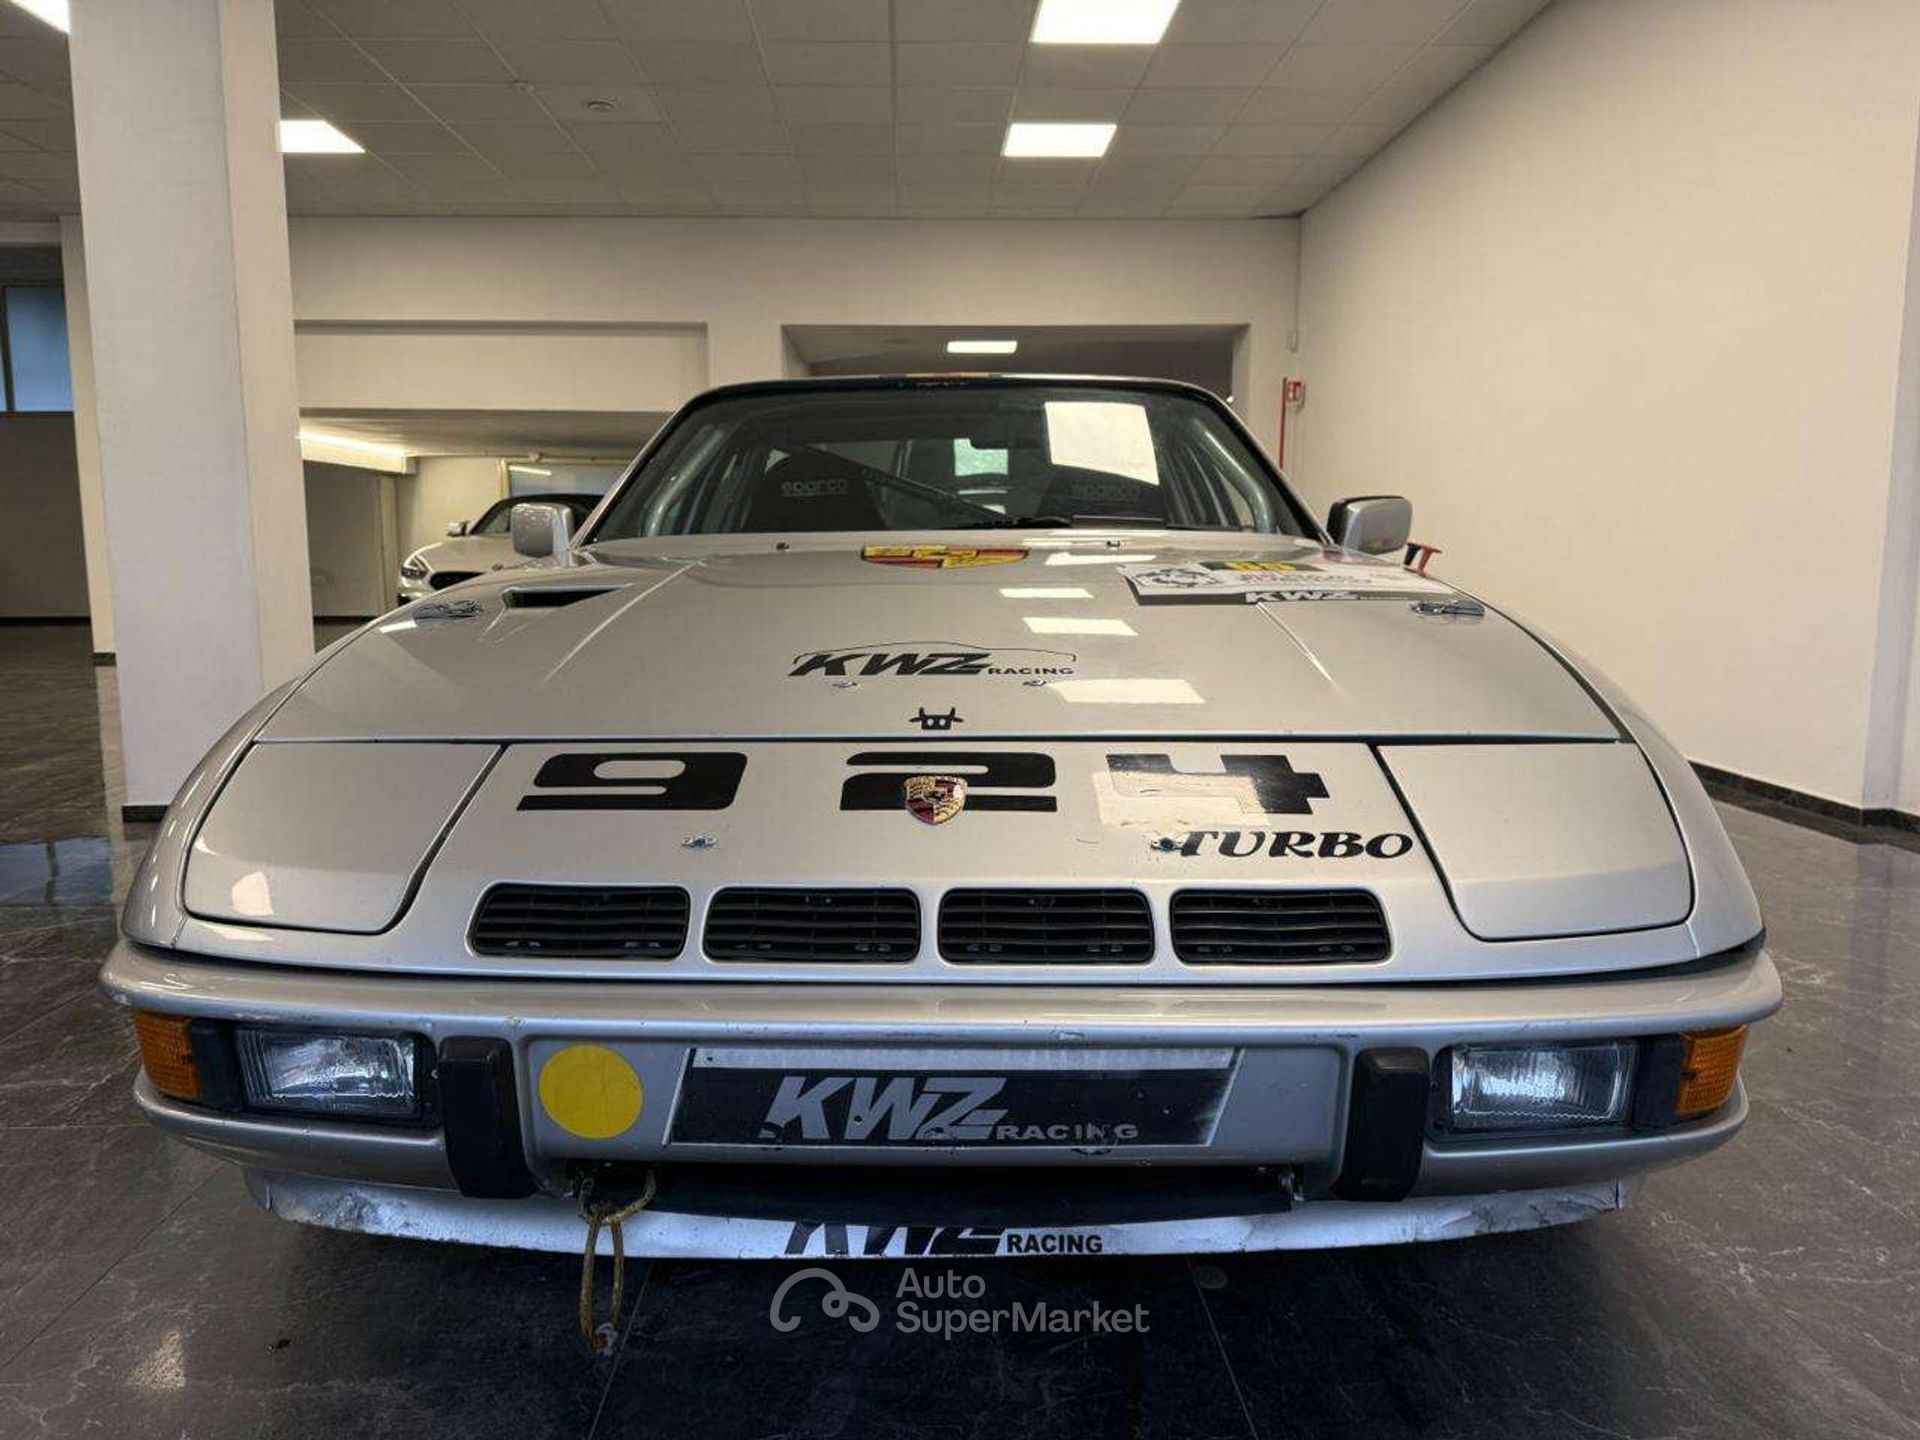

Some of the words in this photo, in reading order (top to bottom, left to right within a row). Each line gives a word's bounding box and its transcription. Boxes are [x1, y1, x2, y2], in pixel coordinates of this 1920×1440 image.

[788, 652, 992, 676] KWZ
[987, 666, 1075, 675] RACING
[1180, 829, 1413, 859] TURBO
[759, 1076, 1010, 1141] KWZ
[994, 1121, 1140, 1141] RACING
[1006, 1233, 1103, 1254] RACING
